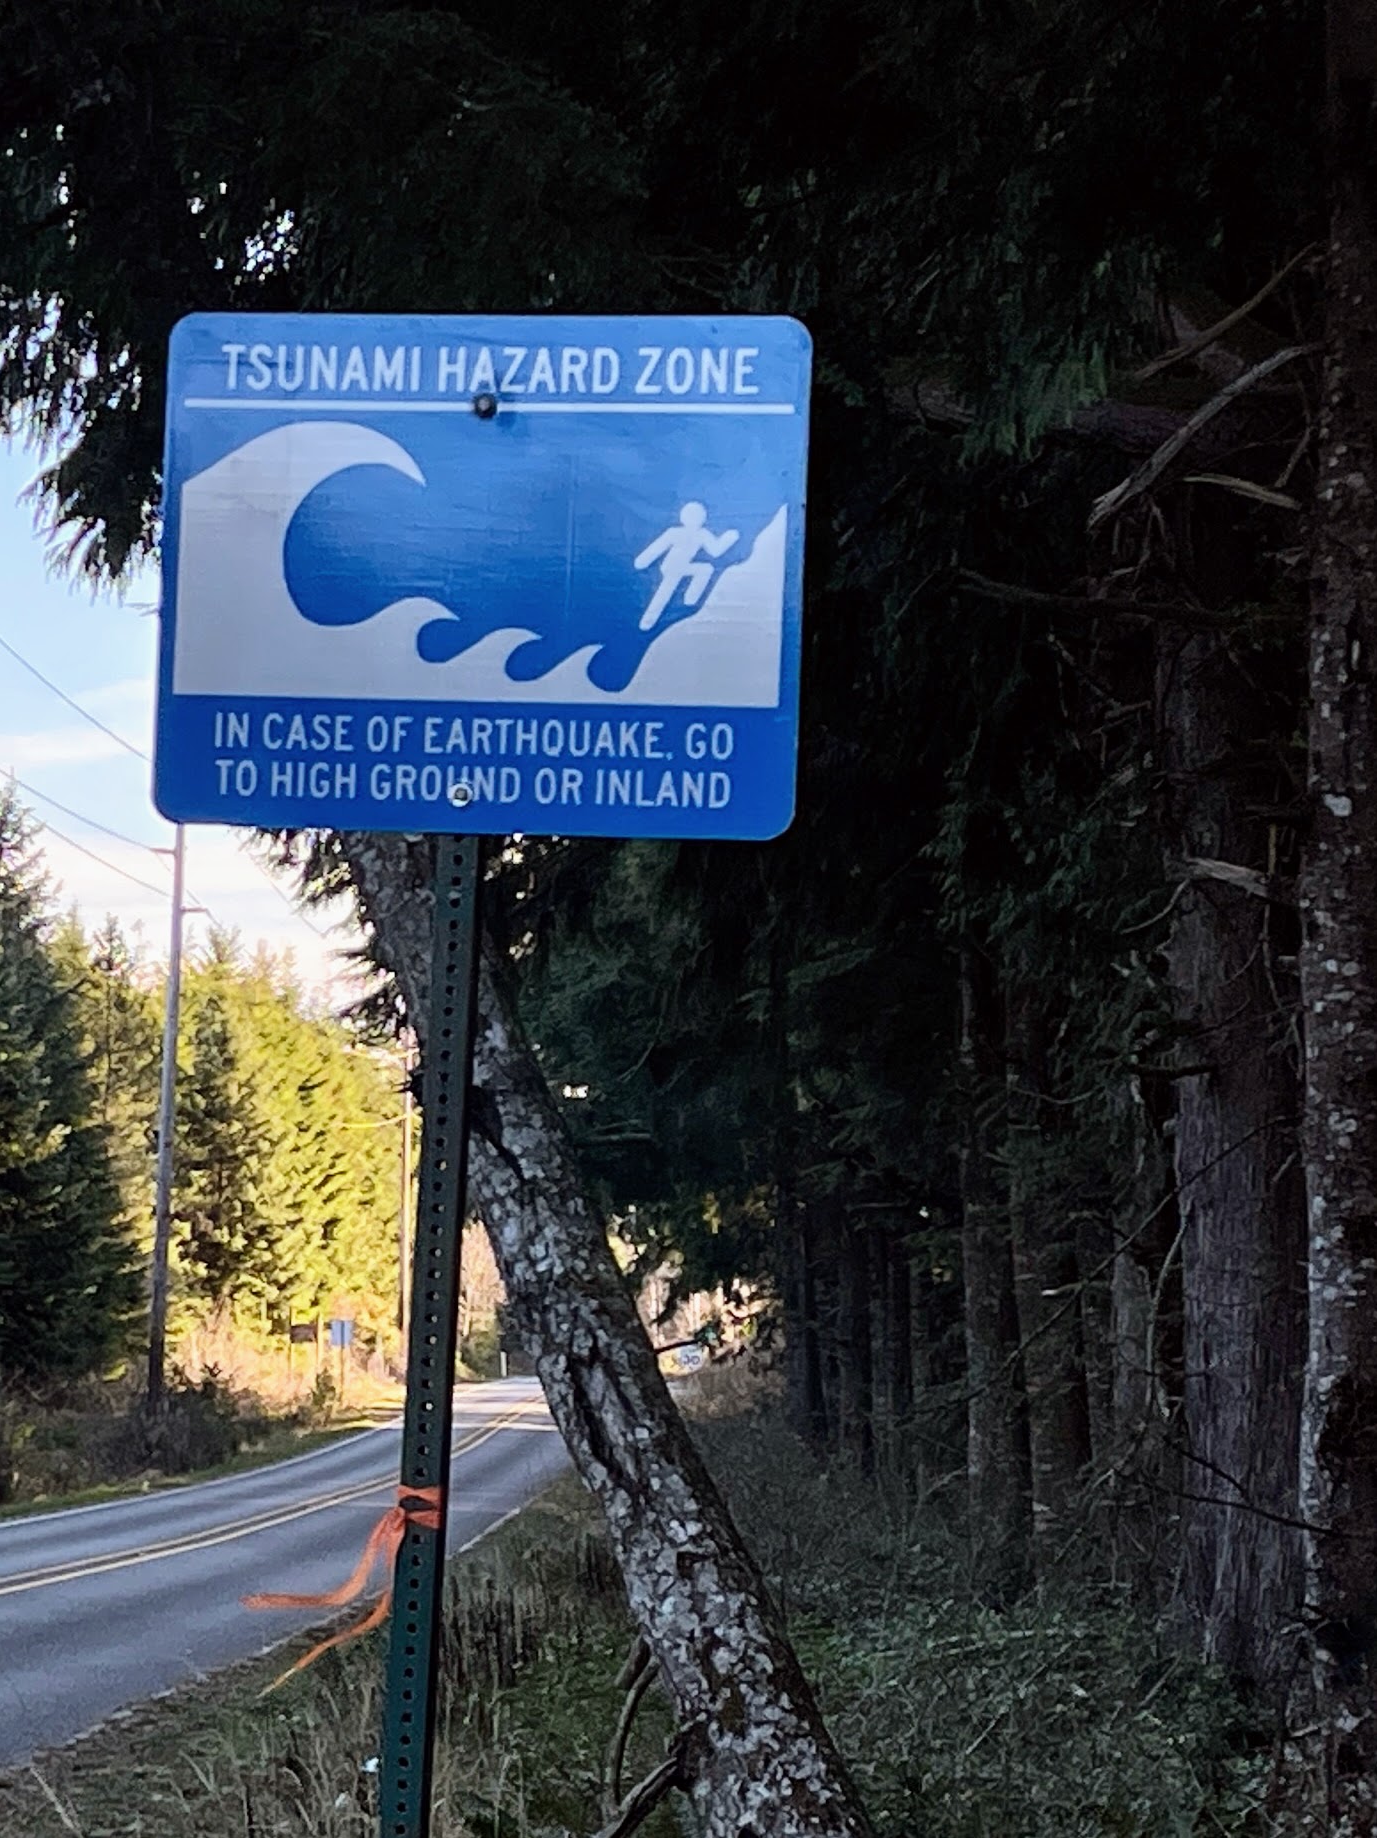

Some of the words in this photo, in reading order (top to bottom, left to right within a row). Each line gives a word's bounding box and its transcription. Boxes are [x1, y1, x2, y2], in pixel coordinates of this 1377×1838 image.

[222, 345, 422, 391] TSUNAMI
[438, 346, 620, 393] HAZARD
[636, 347, 760, 395] ZONE
[214, 712, 250, 749] IN
[263, 714, 354, 752] CASE
[367, 716, 413, 753] OF
[686, 723, 734, 760] GO
[215, 760, 258, 796] TO
[271, 762, 357, 799] HIGH
[535, 767, 583, 805] OR
[596, 769, 731, 808] INLAND
